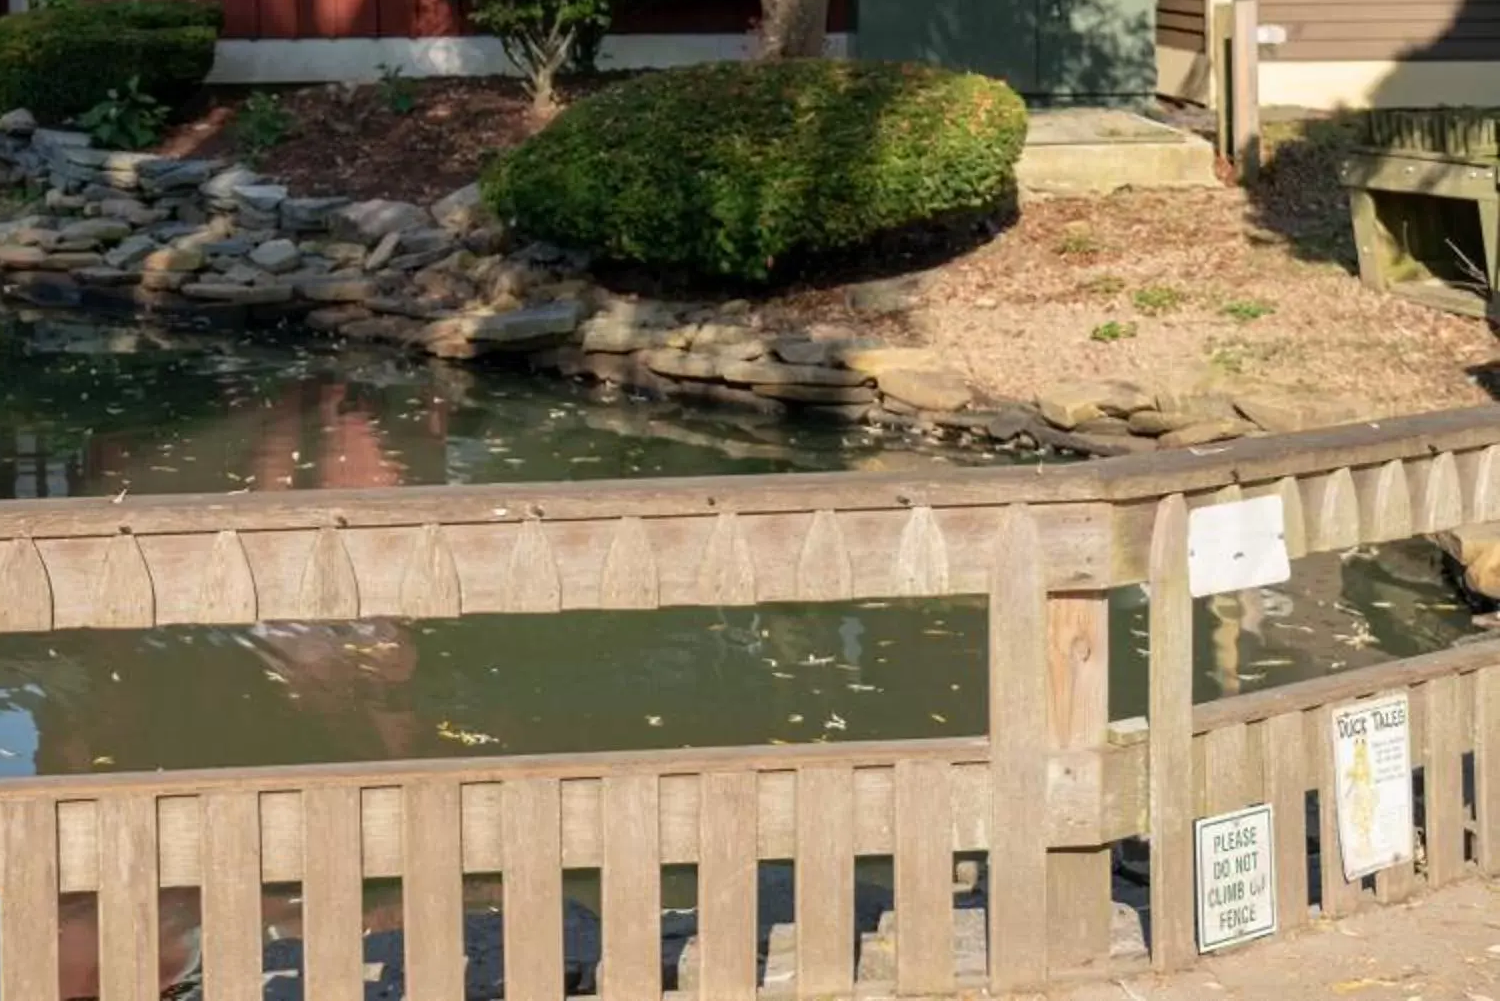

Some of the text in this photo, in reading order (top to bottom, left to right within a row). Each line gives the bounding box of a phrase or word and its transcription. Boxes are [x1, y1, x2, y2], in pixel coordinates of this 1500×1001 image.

[1338, 708, 1405, 739] DUCK TALES
[1213, 826, 1257, 853] PLEASE
[1213, 851, 1258, 880] DO NOT
[1207, 879, 1245, 908] CLIMB
[1219, 904, 1256, 930] FENCE
